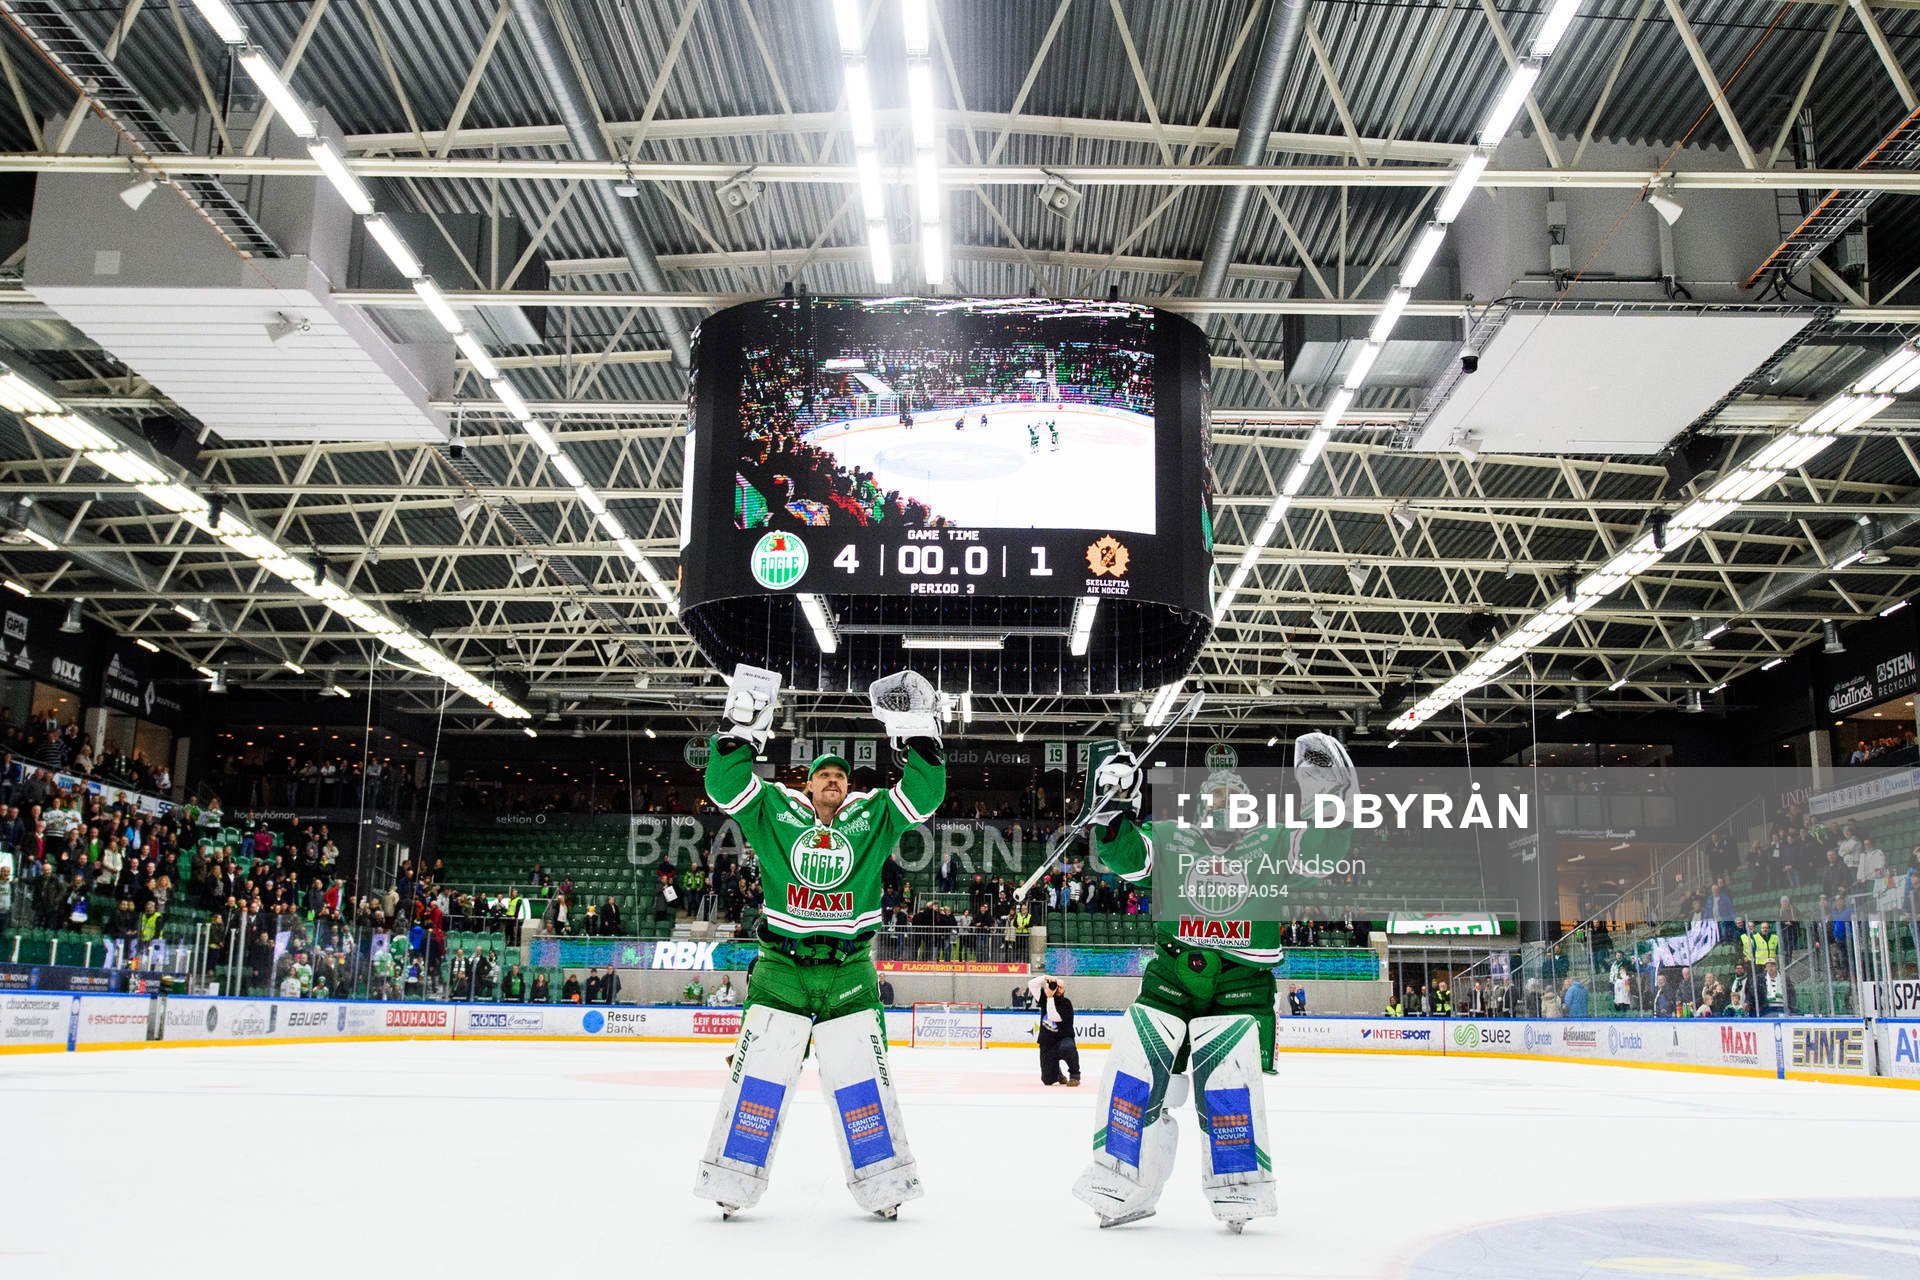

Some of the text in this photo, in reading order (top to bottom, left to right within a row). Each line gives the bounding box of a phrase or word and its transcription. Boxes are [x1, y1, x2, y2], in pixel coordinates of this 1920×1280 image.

[907, 530, 980, 541] GAME TIME
[833, 544, 859, 574] 4
[898, 545, 988, 575] 00.0
[1030, 546, 1053, 576] 1
[910, 583, 975, 594] PERIOD 3
[1085, 579, 1130, 588] SKELLEFTEÅ
[1086, 586, 1129, 595] AIK HOCKEY
[5, 616, 26, 636] GPA
[1878, 673, 1917, 697] RECYCLIN
[858, 746, 872, 760] 13
[983, 749, 1031, 764] Arena
[1049, 749, 1063, 762] 19
[671, 816, 696, 827] N/O
[935, 820, 985, 832] sektion N
[801, 850, 845, 872] RÖGLE
[787, 883, 853, 912] MAXI
[1179, 914, 1251, 939] MAXI
[651, 941, 720, 970] RBK
[902, 964, 999, 973] FLAGGFABRIKEN KRONAN
[386, 1010, 447, 1026] BAUHAUS
[471, 1013, 507, 1027] KÖKS
[607, 1011, 646, 1022] Resurs
[694, 1017, 741, 1025] LEIF OLSSON
[606, 1023, 635, 1034] Bank
[1372, 1029, 1431, 1040] INTERSPORT
[1480, 1027, 1511, 1044] suez
[1534, 1030, 1552, 1046] Lindab
[1618, 1031, 1642, 1049] Lindab
[1720, 1025, 1758, 1055] MAXI
[738, 1111, 772, 1126] CERNITOL
[847, 1115, 880, 1130] CERNITOL
[1112, 1108, 1140, 1125] CERNITOL
[1113, 1115, 1136, 1130] NOVUM
[740, 1118, 767, 1131] NOVUM
[852, 1120, 879, 1134] NOVUM
[1213, 1126, 1248, 1135] CERNITOL
